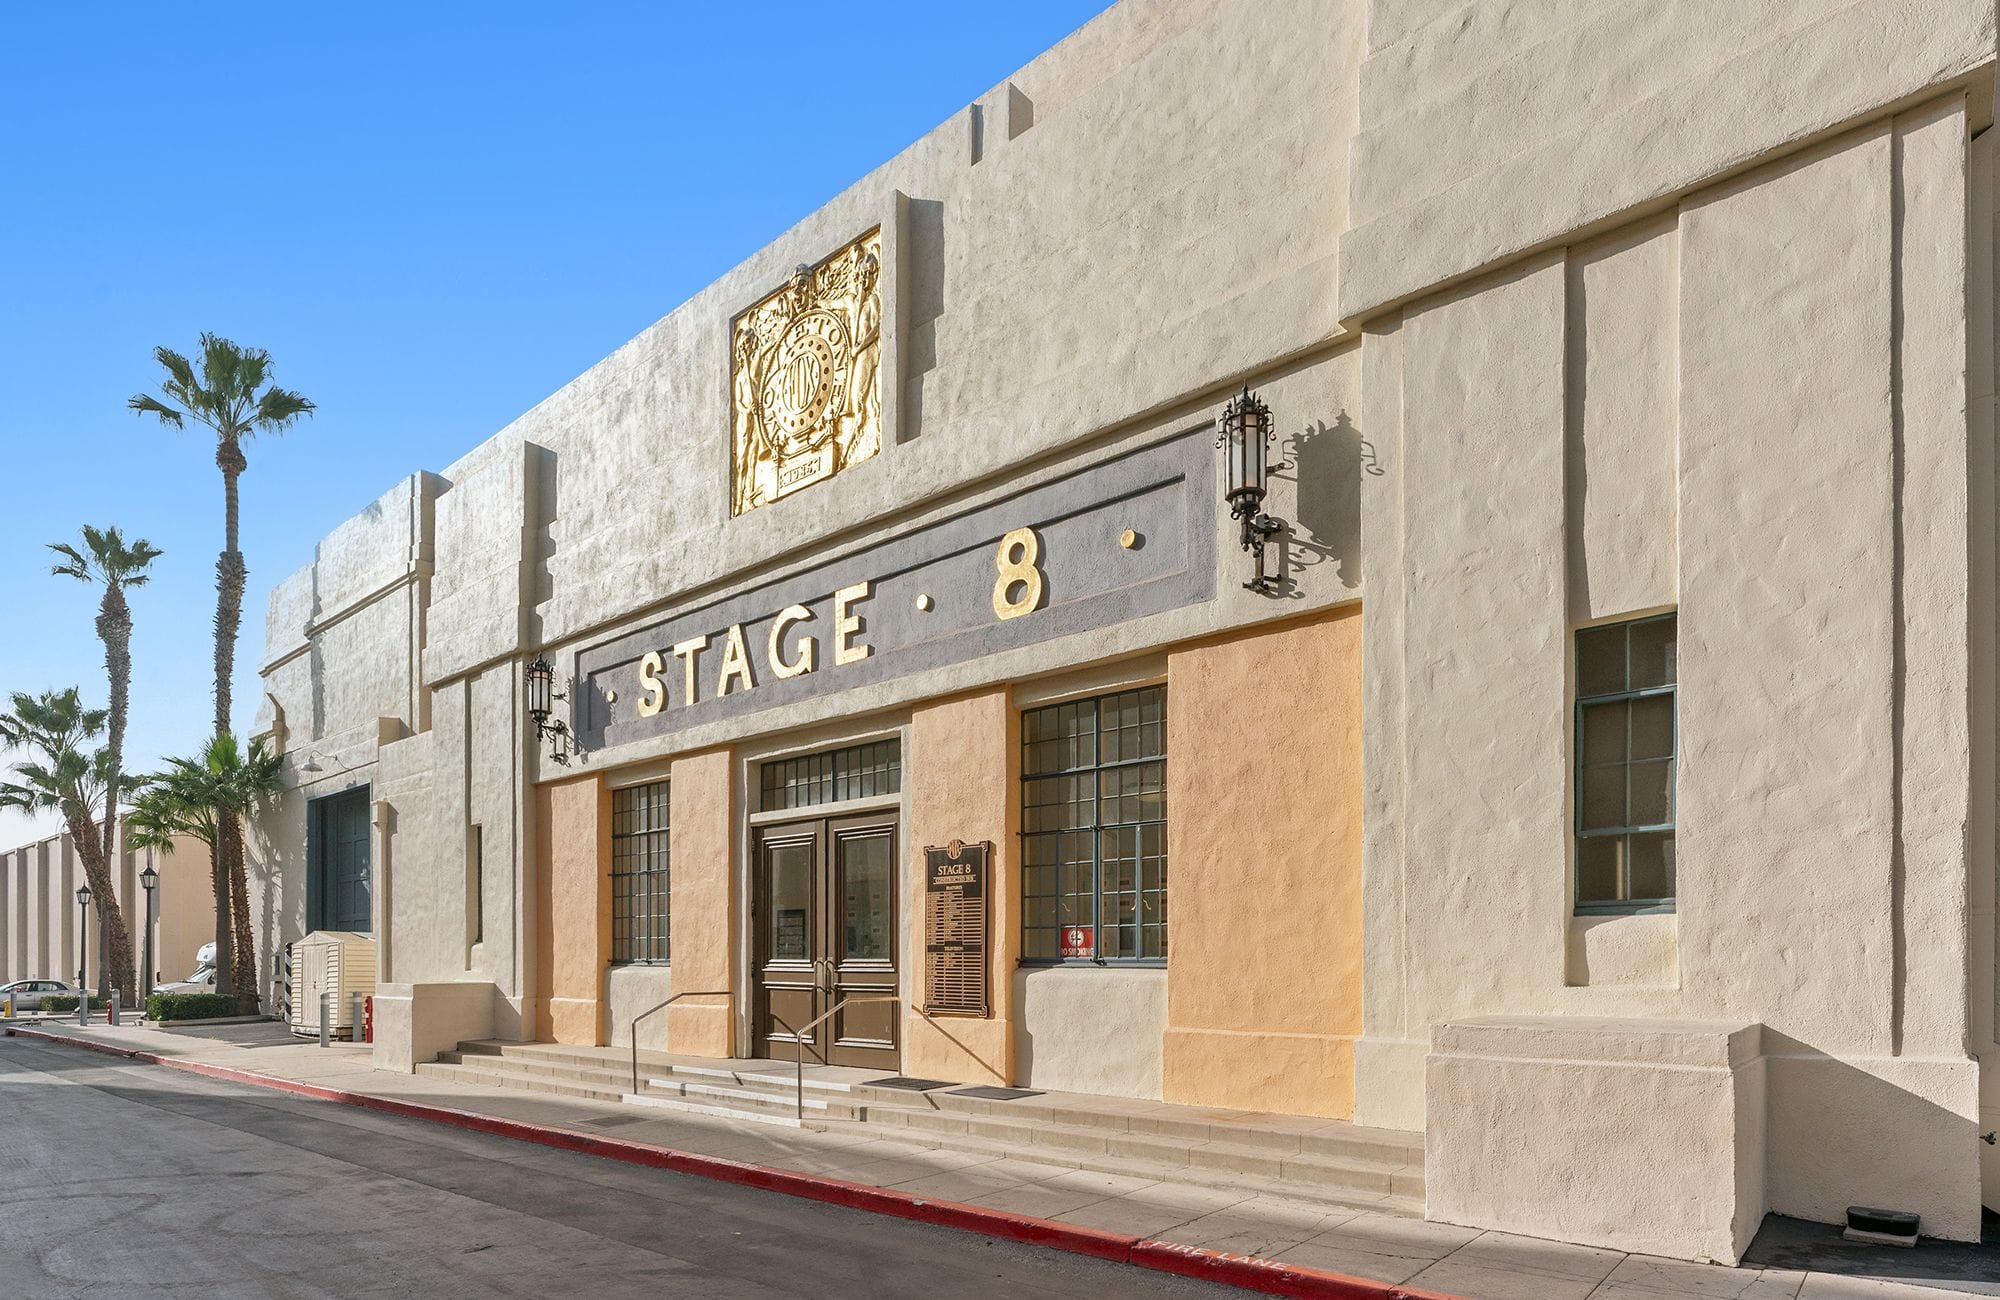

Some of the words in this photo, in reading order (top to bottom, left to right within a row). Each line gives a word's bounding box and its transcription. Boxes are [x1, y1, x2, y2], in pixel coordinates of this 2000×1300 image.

[636, 580, 873, 718] STAGE
[992, 526, 1044, 621] 8
[937, 864, 964, 876] STAGE
[965, 863, 972, 874] 8
[1150, 1240, 1209, 1257] FIRE
[1216, 1252, 1291, 1271] LANE
